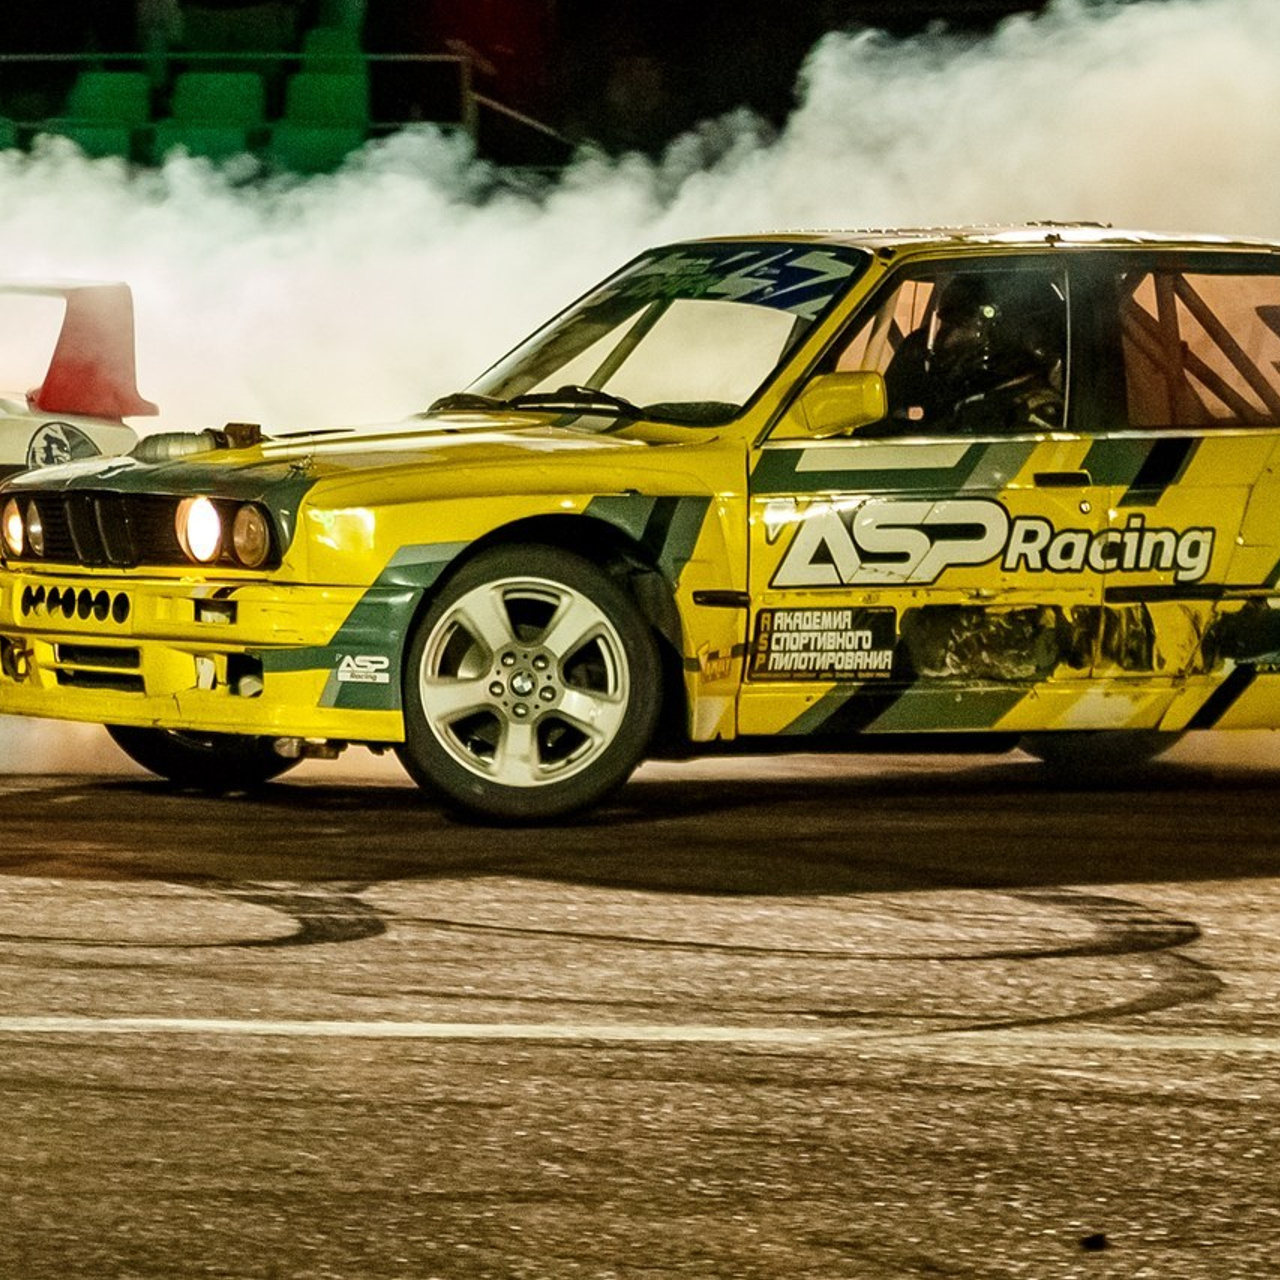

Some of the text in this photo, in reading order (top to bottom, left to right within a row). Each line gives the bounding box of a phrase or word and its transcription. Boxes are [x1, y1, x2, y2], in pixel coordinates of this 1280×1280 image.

[769, 500, 1214, 586] ASP Racing
[773, 610, 852, 631] АКАДЕМИЯ
[770, 630, 872, 651] СПОРТИВНОГО
[338, 654, 390, 673] ASP
[767, 650, 893, 671] ПИЛОТИРОВАНИЯ
